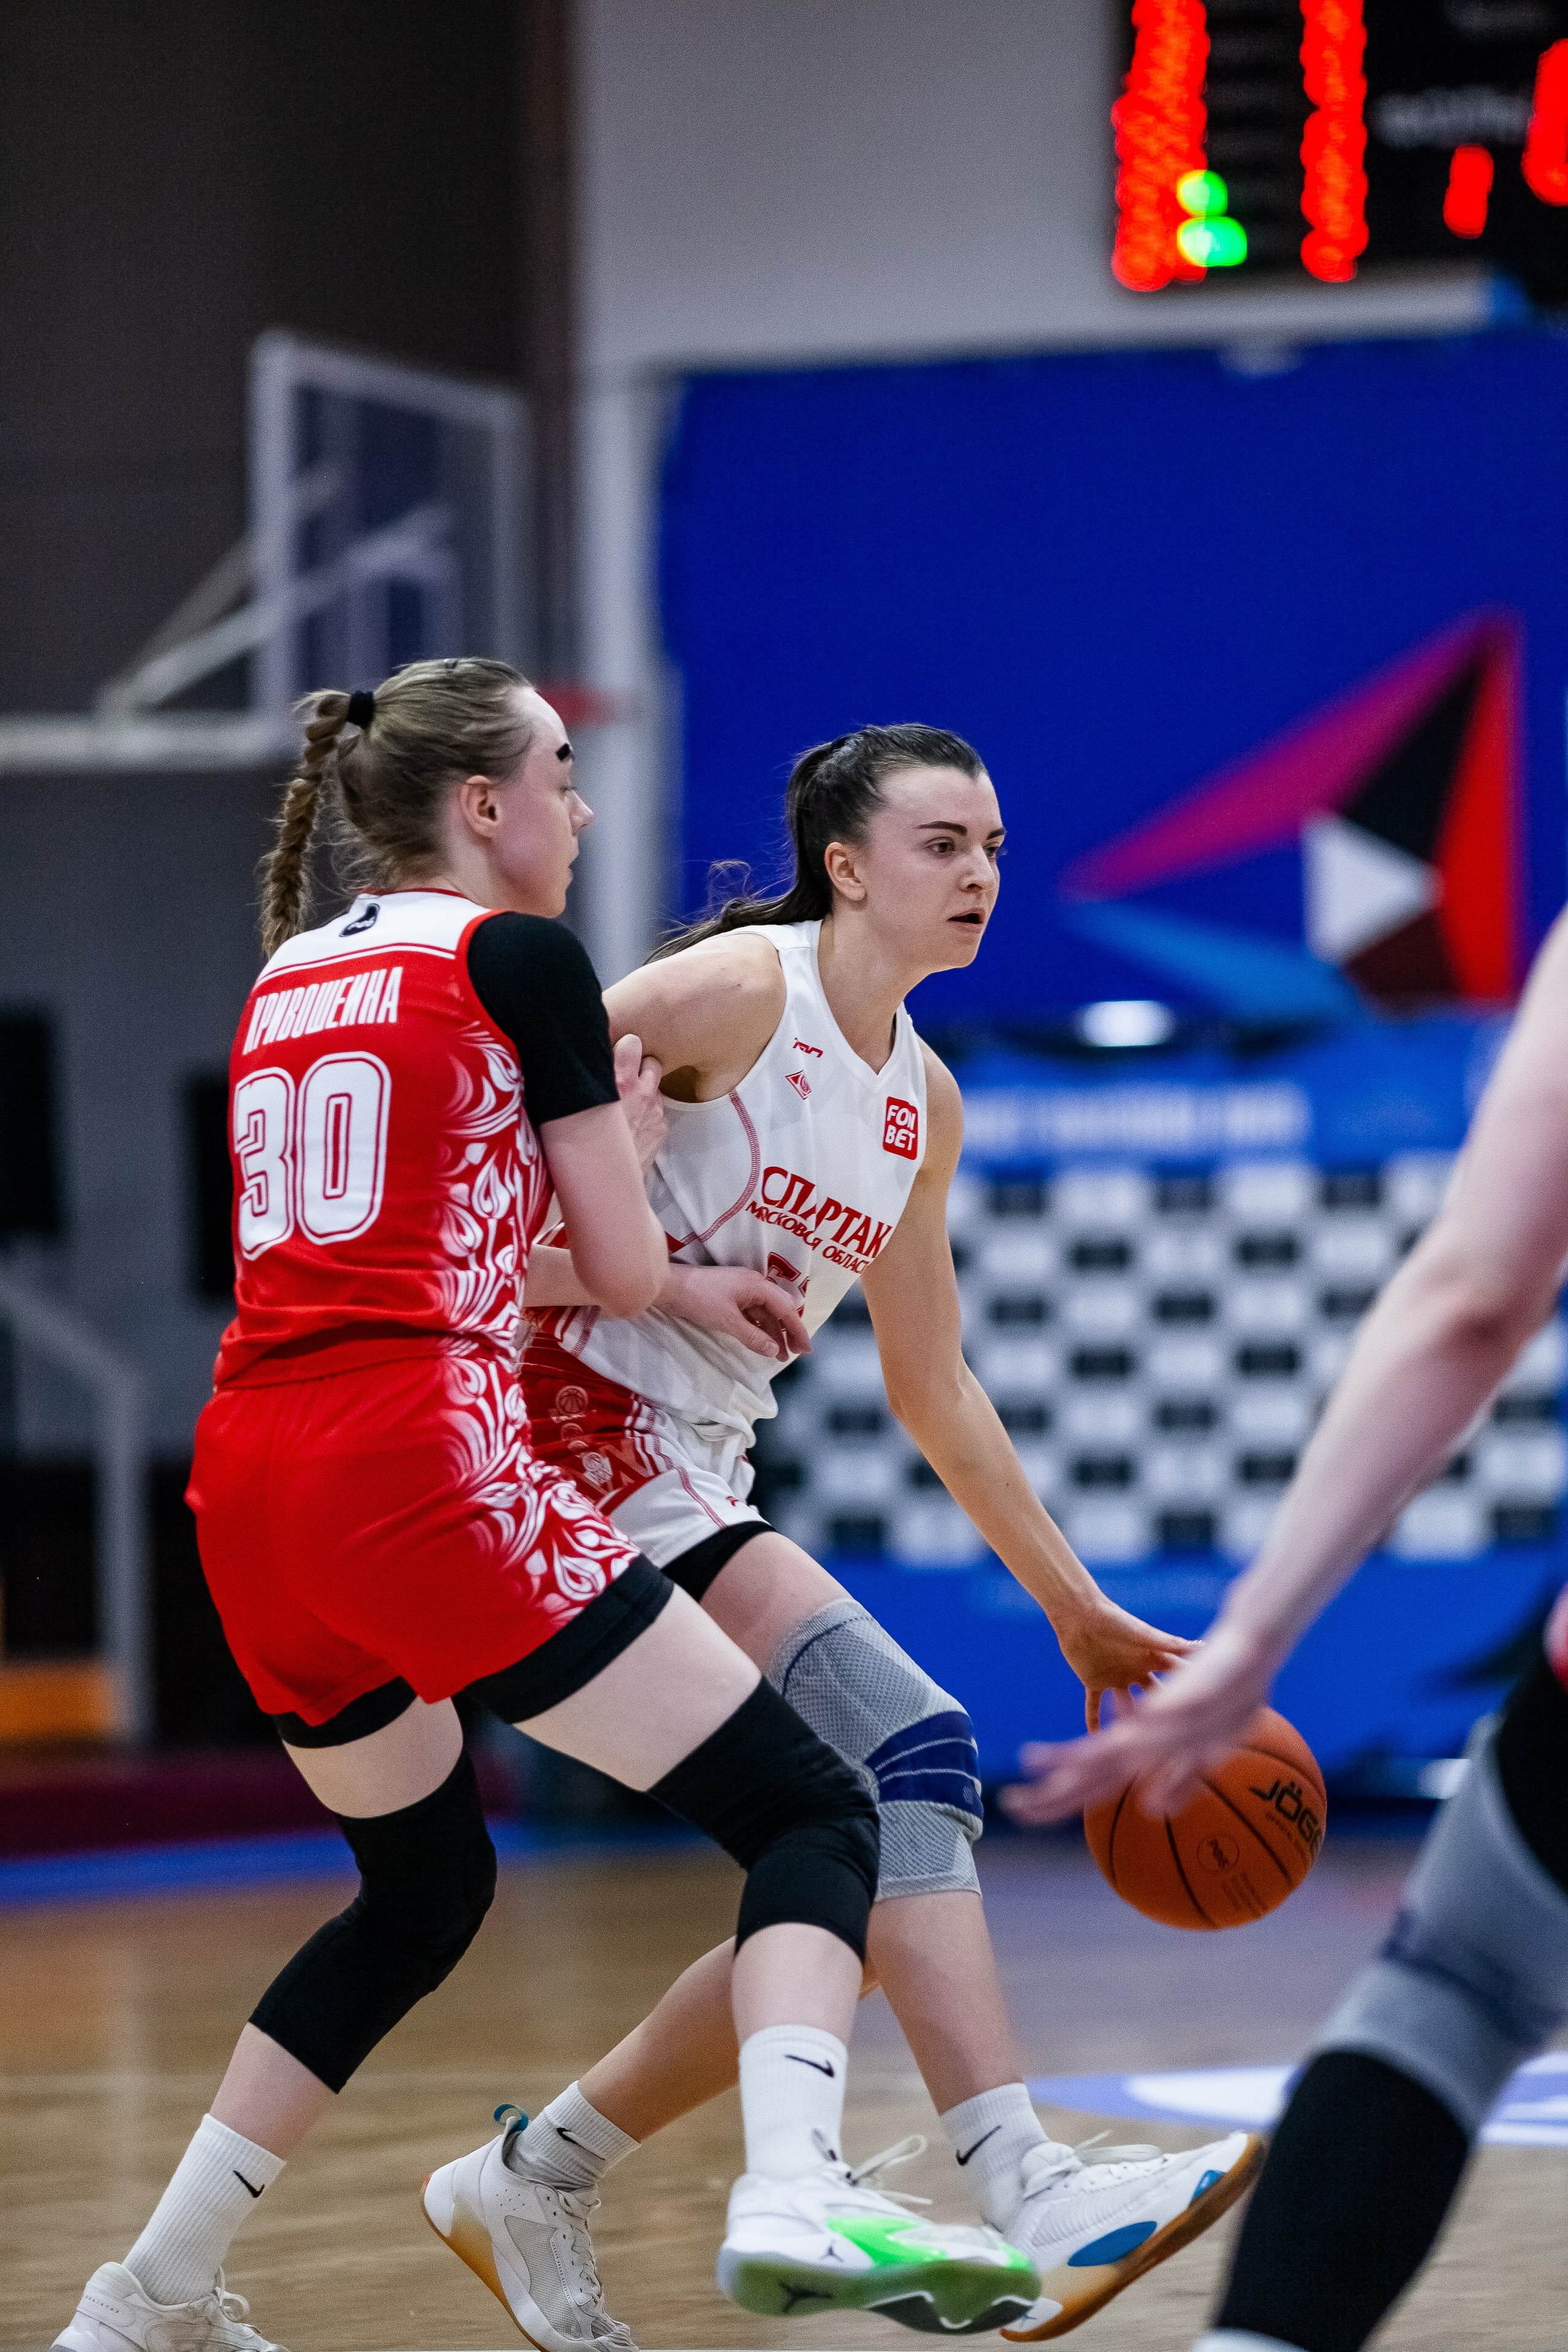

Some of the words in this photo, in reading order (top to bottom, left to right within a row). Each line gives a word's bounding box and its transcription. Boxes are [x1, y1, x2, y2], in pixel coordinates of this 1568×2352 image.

[242, 966, 404, 1055] КРИВОШЕИНА
[884, 1124, 916, 1151] BET
[886, 1104, 916, 1131] FON
[235, 1050, 392, 1262] 30
